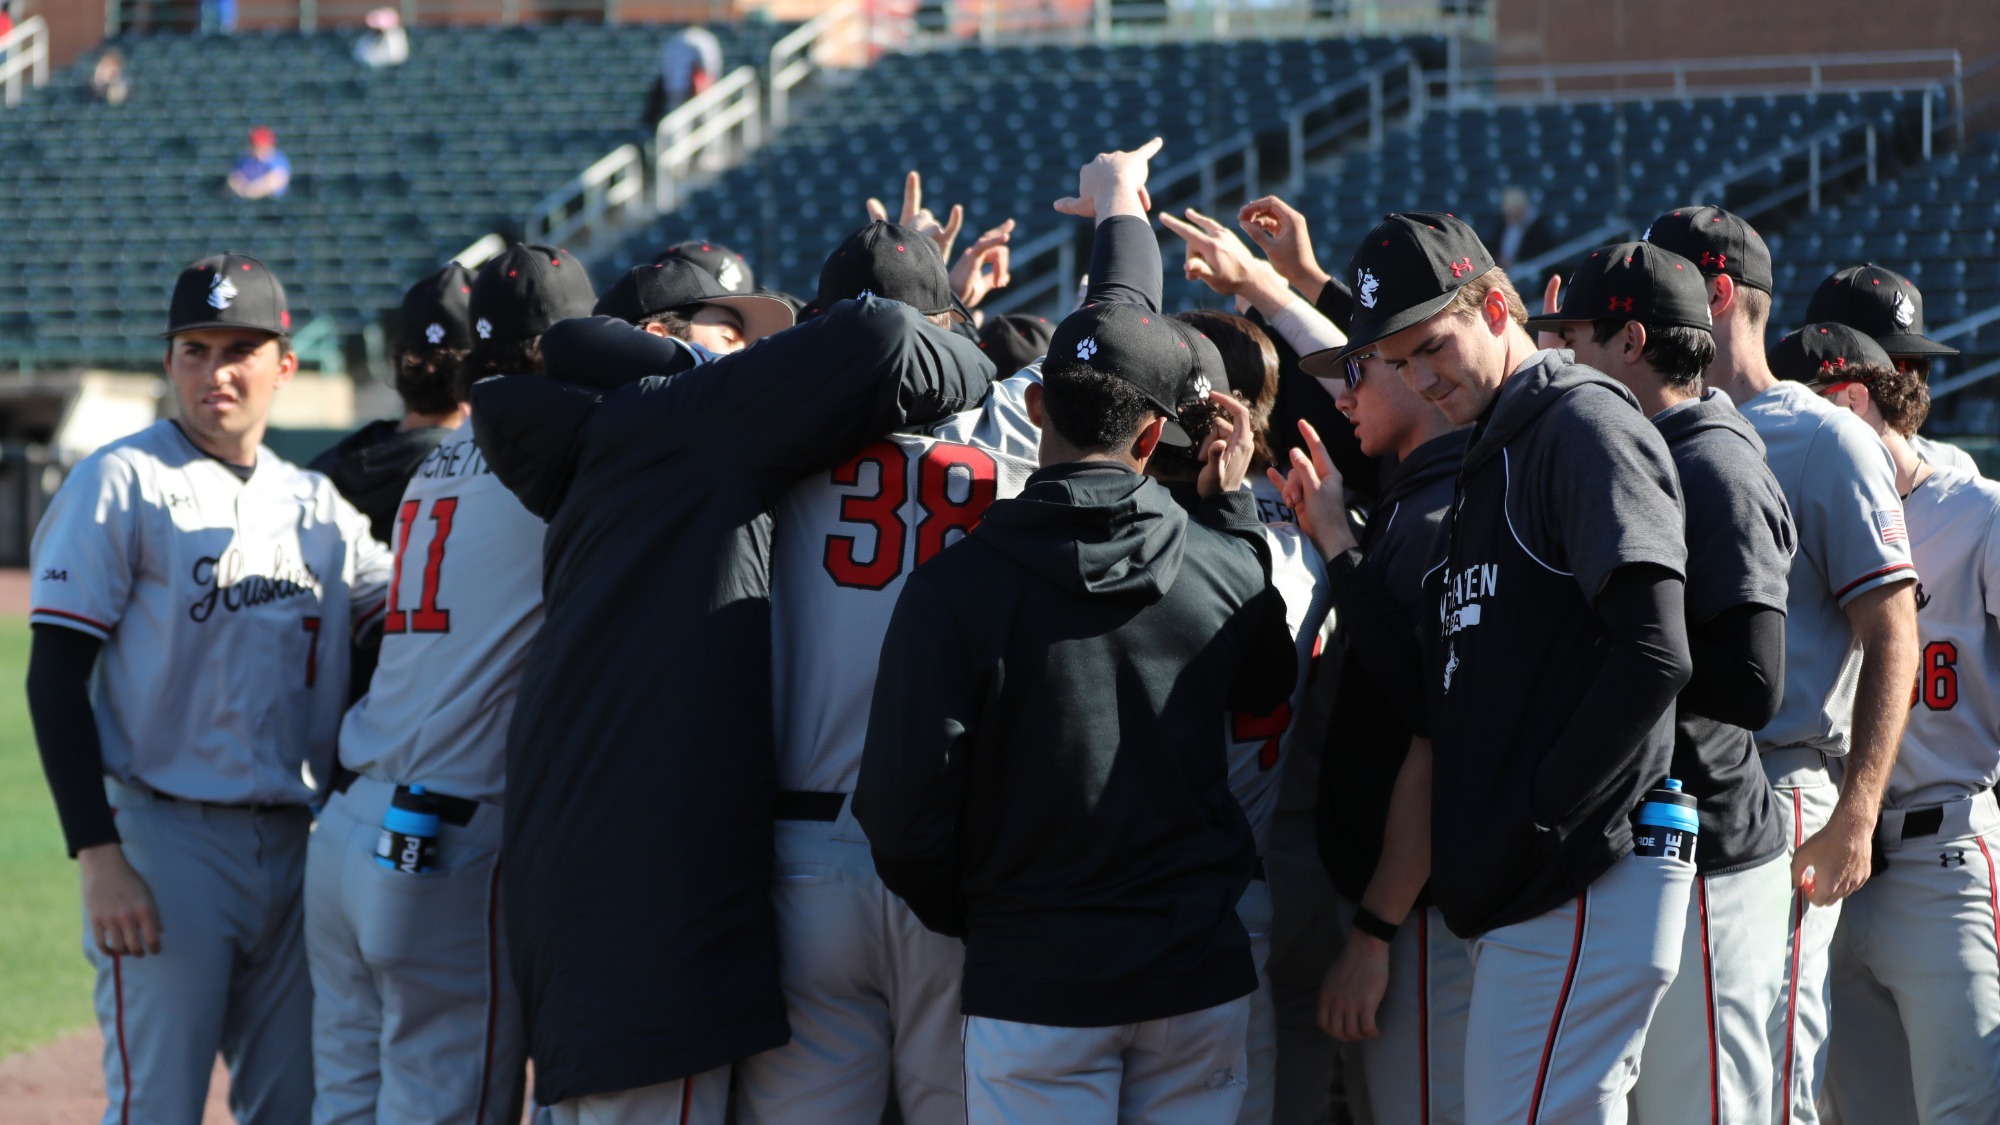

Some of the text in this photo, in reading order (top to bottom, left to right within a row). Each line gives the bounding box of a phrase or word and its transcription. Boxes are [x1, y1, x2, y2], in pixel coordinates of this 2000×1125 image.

[383, 497, 458, 634] 11
[823, 441, 997, 591] 38
[303, 617, 321, 688] 7
[1910, 641, 1958, 711] 6
